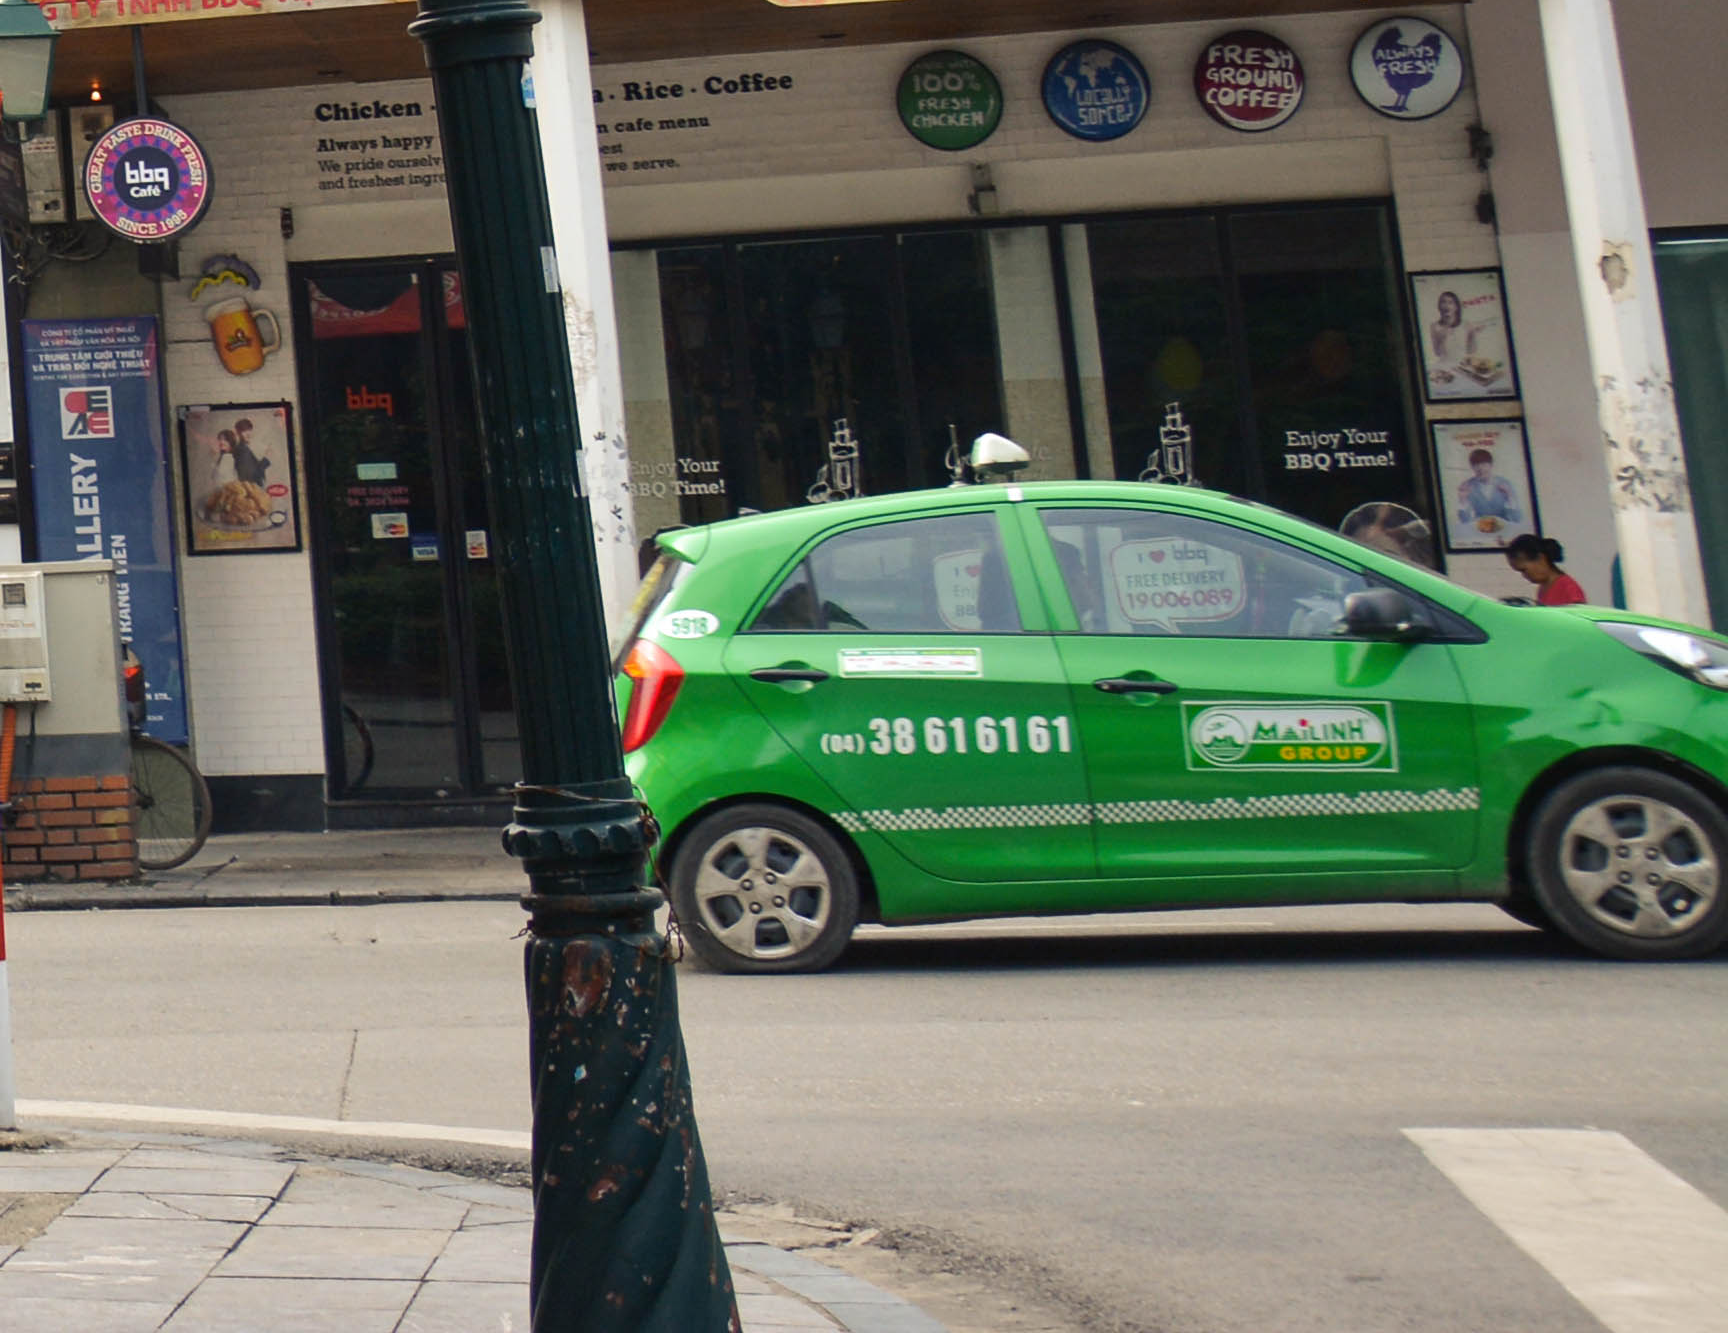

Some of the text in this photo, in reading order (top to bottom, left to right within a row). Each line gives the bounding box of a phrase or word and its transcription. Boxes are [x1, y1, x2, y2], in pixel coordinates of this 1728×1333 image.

[1208, 44, 1294, 69] FRESH
[1375, 45, 1434, 60] ALWAYS
[1206, 66, 1295, 90] GROUND
[314, 100, 422, 123] Chicken
[622, 80, 684, 103] Rice
[704, 74, 793, 96] Coffee
[1206, 87, 1295, 109] COFFEE
[317, 135, 378, 154] Always
[382, 132, 435, 152] happy
[615, 118, 656, 134] cafe
[659, 115, 711, 131] menu
[91, 124, 202, 193] GREAT TASTE DRINK FRESH
[344, 155, 385, 176] pride
[388, 153, 443, 171] ourselv
[125, 161, 169, 190] bbq
[319, 176, 345, 191] and
[348, 173, 406, 191] freshest
[631, 156, 681, 172] serve.
[130, 185, 161, 198] Café
[116, 217, 158, 234] SINCE
[345, 385, 393, 417] bbq
[1286, 428, 1389, 450] Enjoy Your
[678, 458, 721, 474] Your
[1284, 450, 1395, 472] BBQ Time!
[674, 478, 727, 496] Time!
[70, 453, 103, 560] LLERY
[1126, 570, 1226, 589] FREE DELIVERY
[821, 733, 866, 754] (04)
[1280, 746, 1368, 761] GROUP
